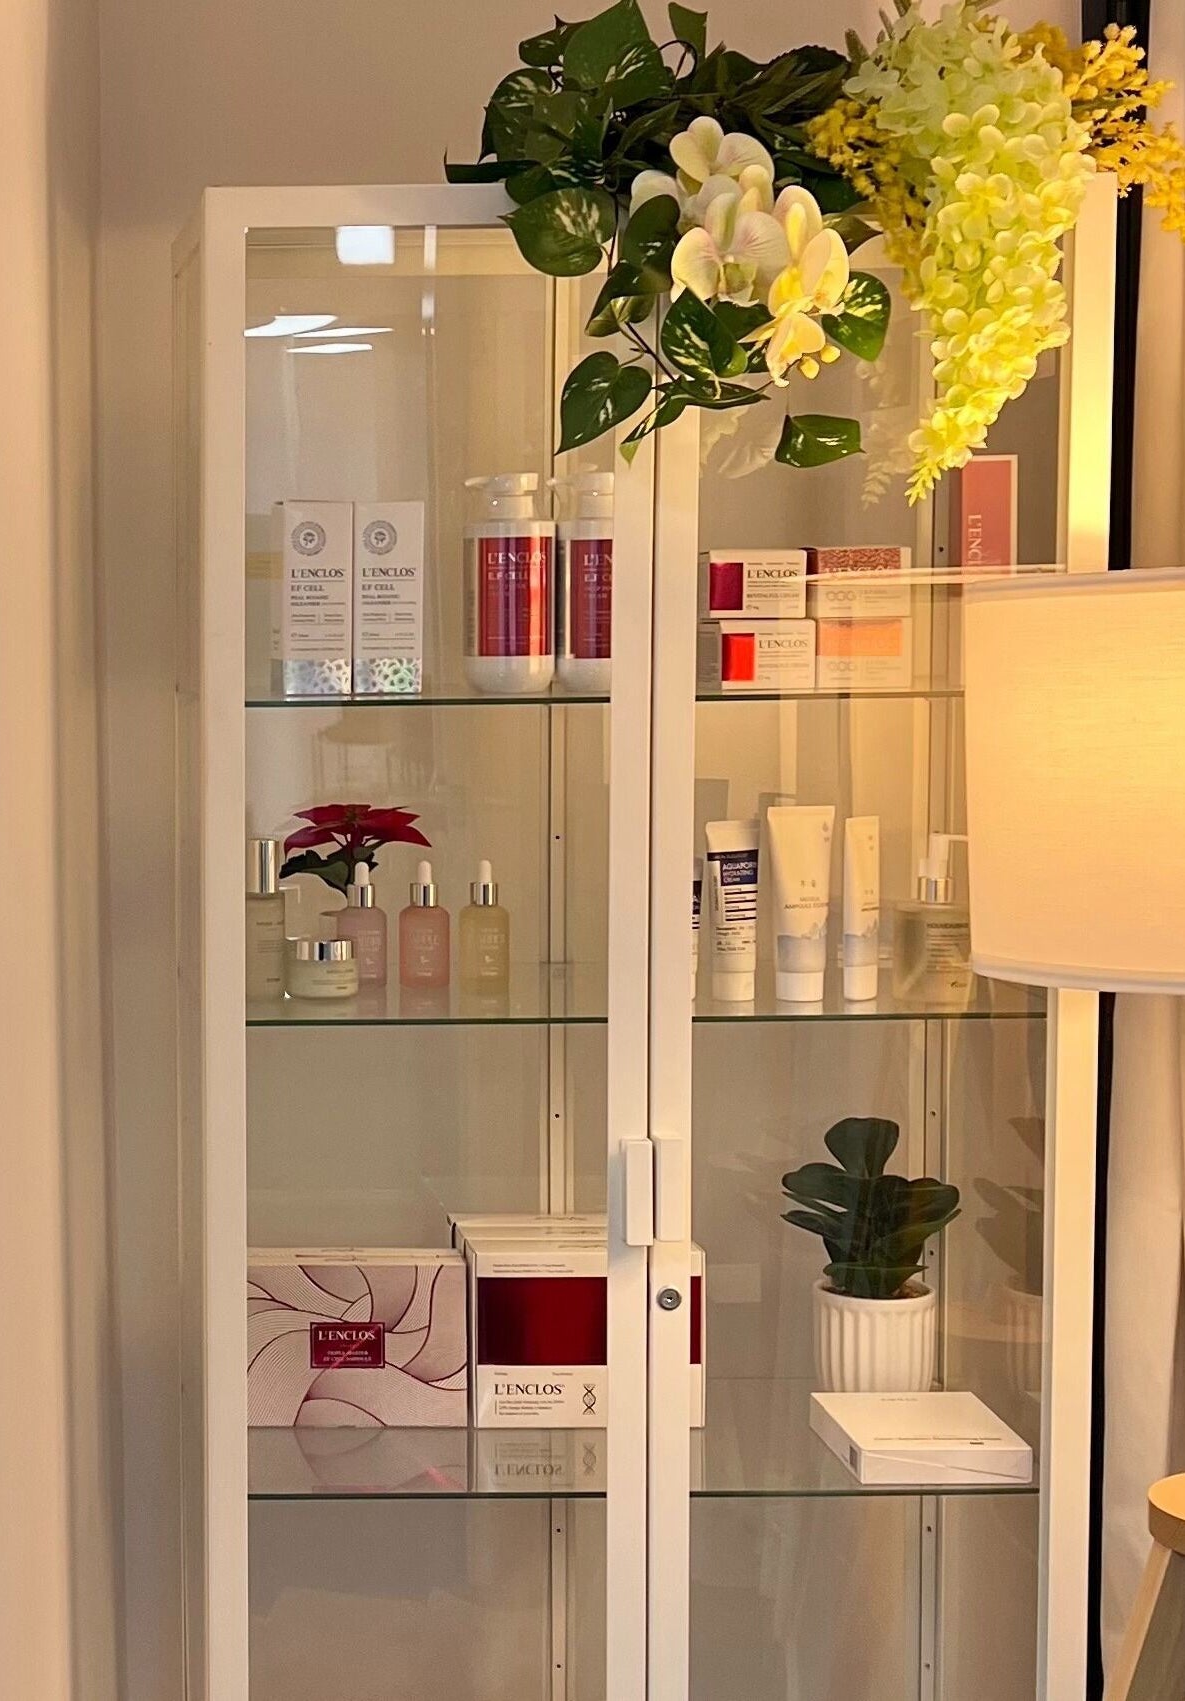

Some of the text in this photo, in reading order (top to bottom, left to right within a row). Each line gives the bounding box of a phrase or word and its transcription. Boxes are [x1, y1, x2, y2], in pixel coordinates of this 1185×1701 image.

[488, 552, 547, 565] L'ENCLOS
[291, 568, 344, 579] L'ENCLOS
[362, 567, 416, 578] L'ENCLOS
[747, 569, 798, 579] L'ENCLOS
[374, 583, 396, 591] CELL
[758, 639, 809, 649] L'ENCLOS
[318, 1330, 376, 1341] L'ENCLOS
[494, 1383, 563, 1396] L'ENCLOS
